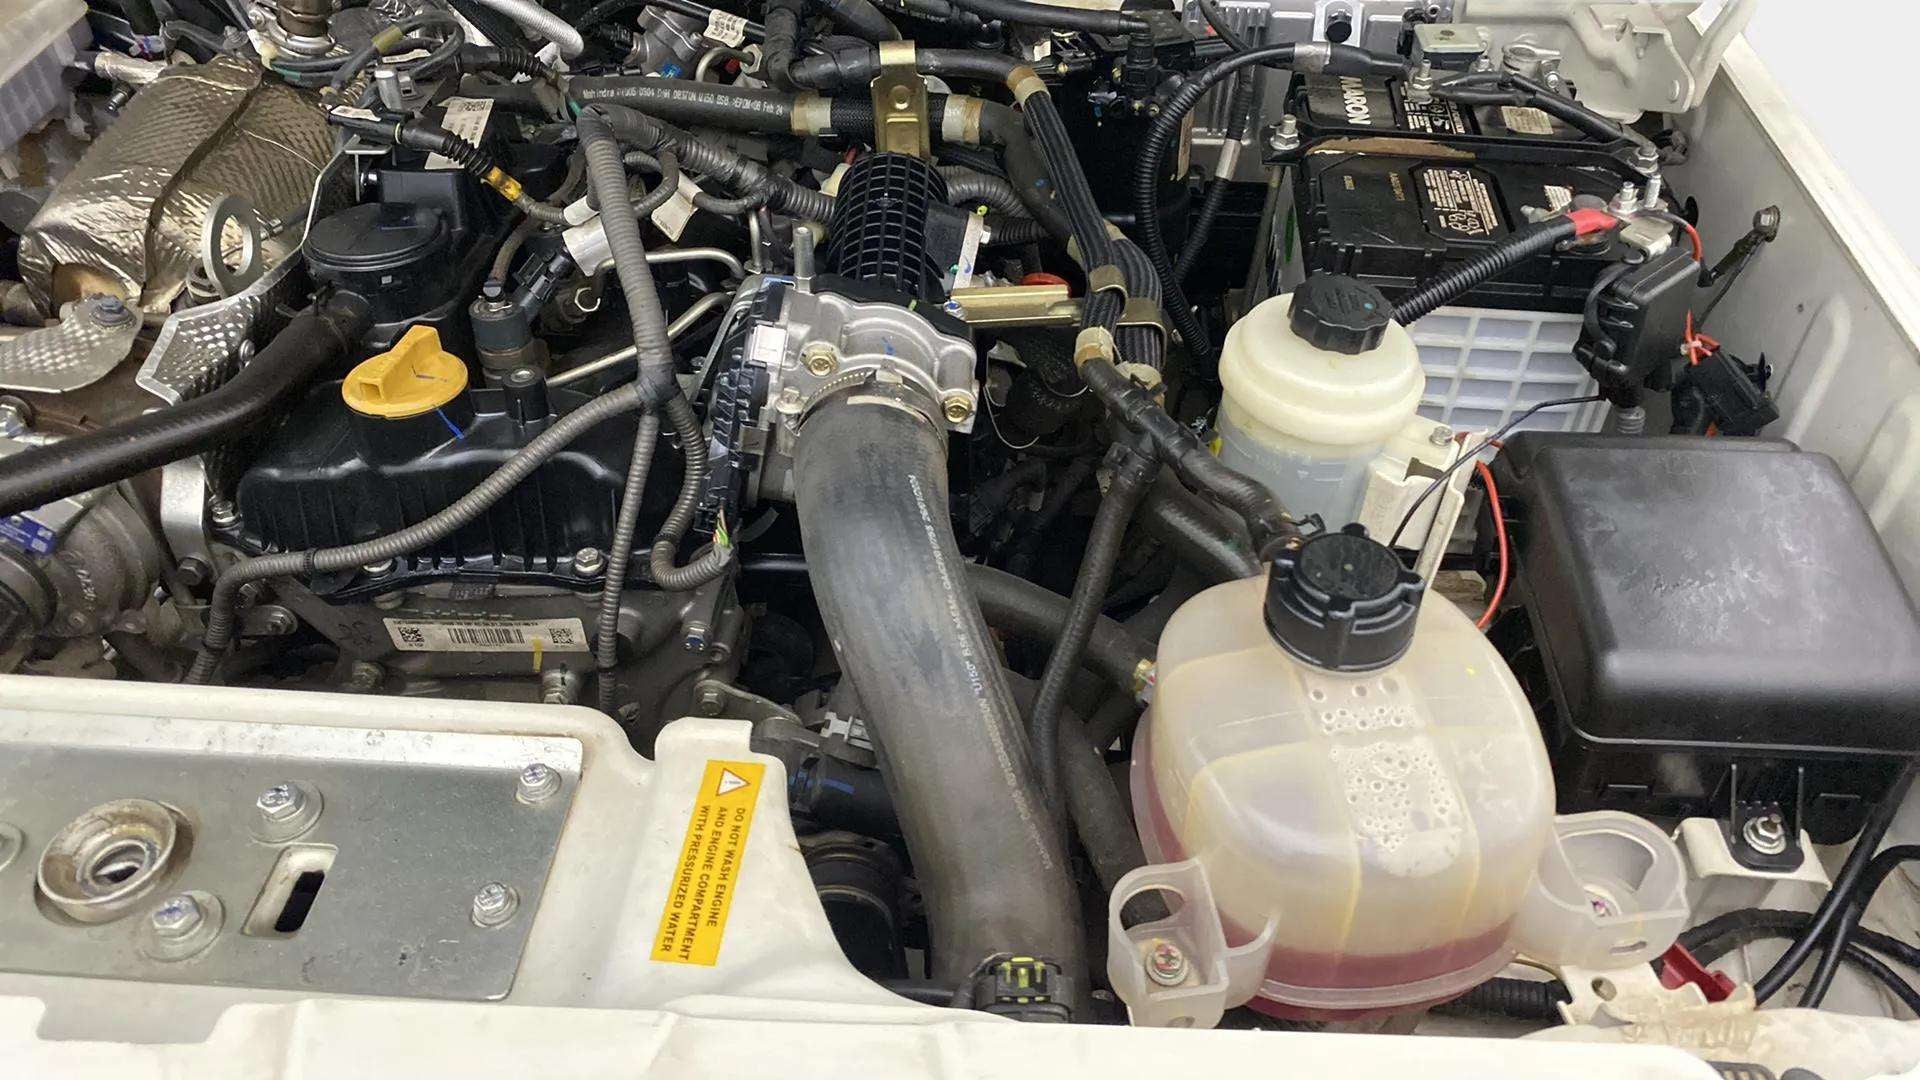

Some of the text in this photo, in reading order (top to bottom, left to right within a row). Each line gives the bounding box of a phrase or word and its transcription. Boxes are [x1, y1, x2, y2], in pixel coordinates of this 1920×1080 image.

[1338, 76, 1372, 124] MARON
[660, 805, 711, 952] WITH PRESSURIZED WATER
[678, 806, 728, 960] AND ENGINE COMPARTMENT
[706, 808, 746, 928] DO NOT WASH ENGINE
